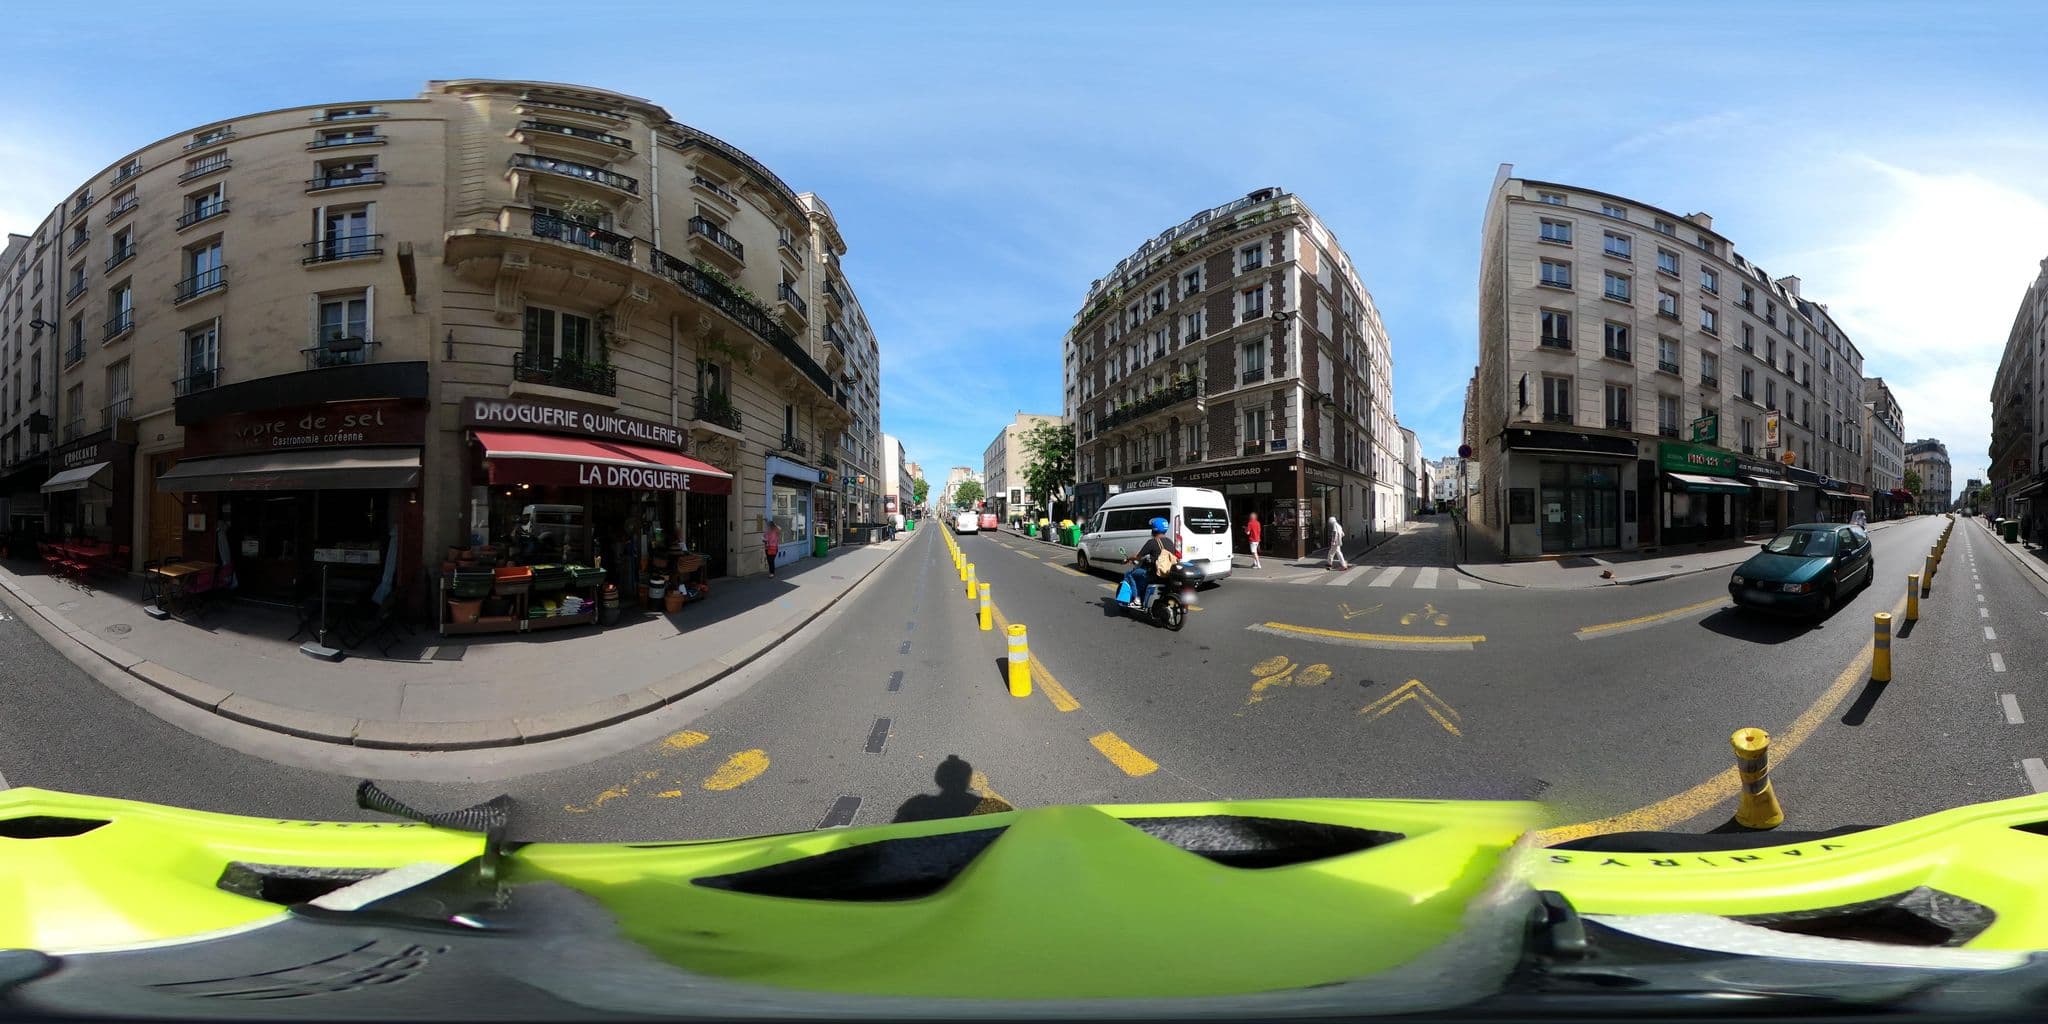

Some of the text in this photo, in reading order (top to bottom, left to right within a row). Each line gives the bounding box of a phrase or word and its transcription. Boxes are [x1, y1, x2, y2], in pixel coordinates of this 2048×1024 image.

[300, 409, 326, 430] de
[344, 407, 384, 427] sel
[475, 402, 676, 444] DROGUERIE QUINCAILLERIE
[273, 429, 363, 446] Gastronomie coréenne
[64, 445, 97, 466] CROCCANTE
[580, 464, 690, 490] LA DROGUERIE
[1221, 467, 1261, 477] VAUGIRARD
